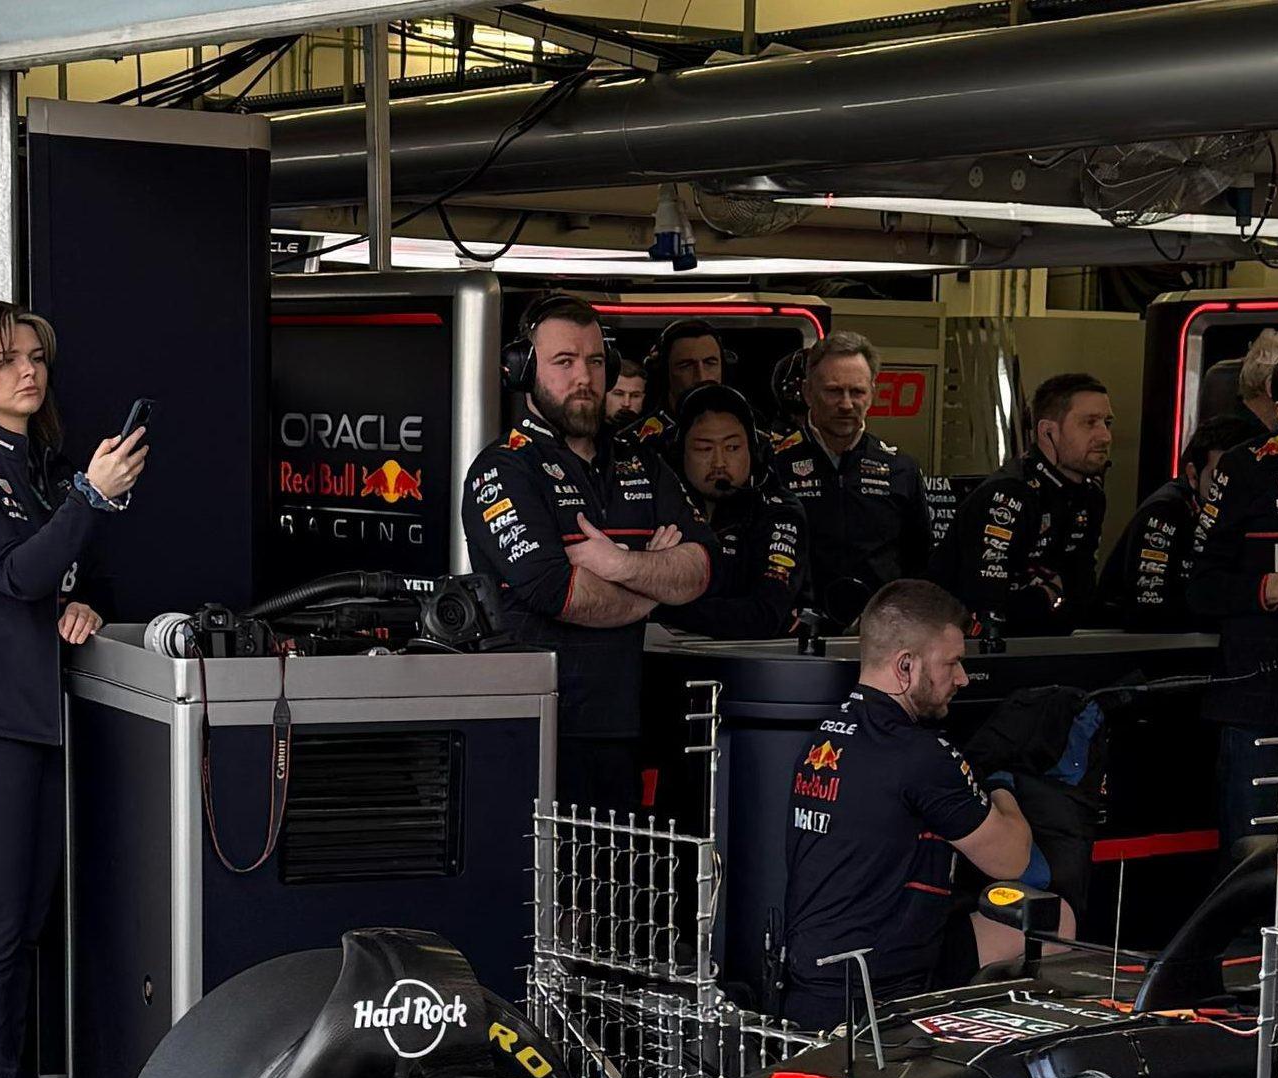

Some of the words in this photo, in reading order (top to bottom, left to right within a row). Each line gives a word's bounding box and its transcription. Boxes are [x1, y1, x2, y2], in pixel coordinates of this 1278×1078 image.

[280, 412, 424, 452] ORACLE
[280, 459, 317, 495] Red
[320, 461, 357, 497] Bull
[924, 476, 952, 491] VISA
[279, 513, 424, 545] RACING
[403, 578, 435, 592] YETI
[276, 740, 287, 779] Canon
[353, 996, 411, 1029] Hard
[412, 994, 468, 1031] Rock
[970, 1009, 1058, 1033] TAG
